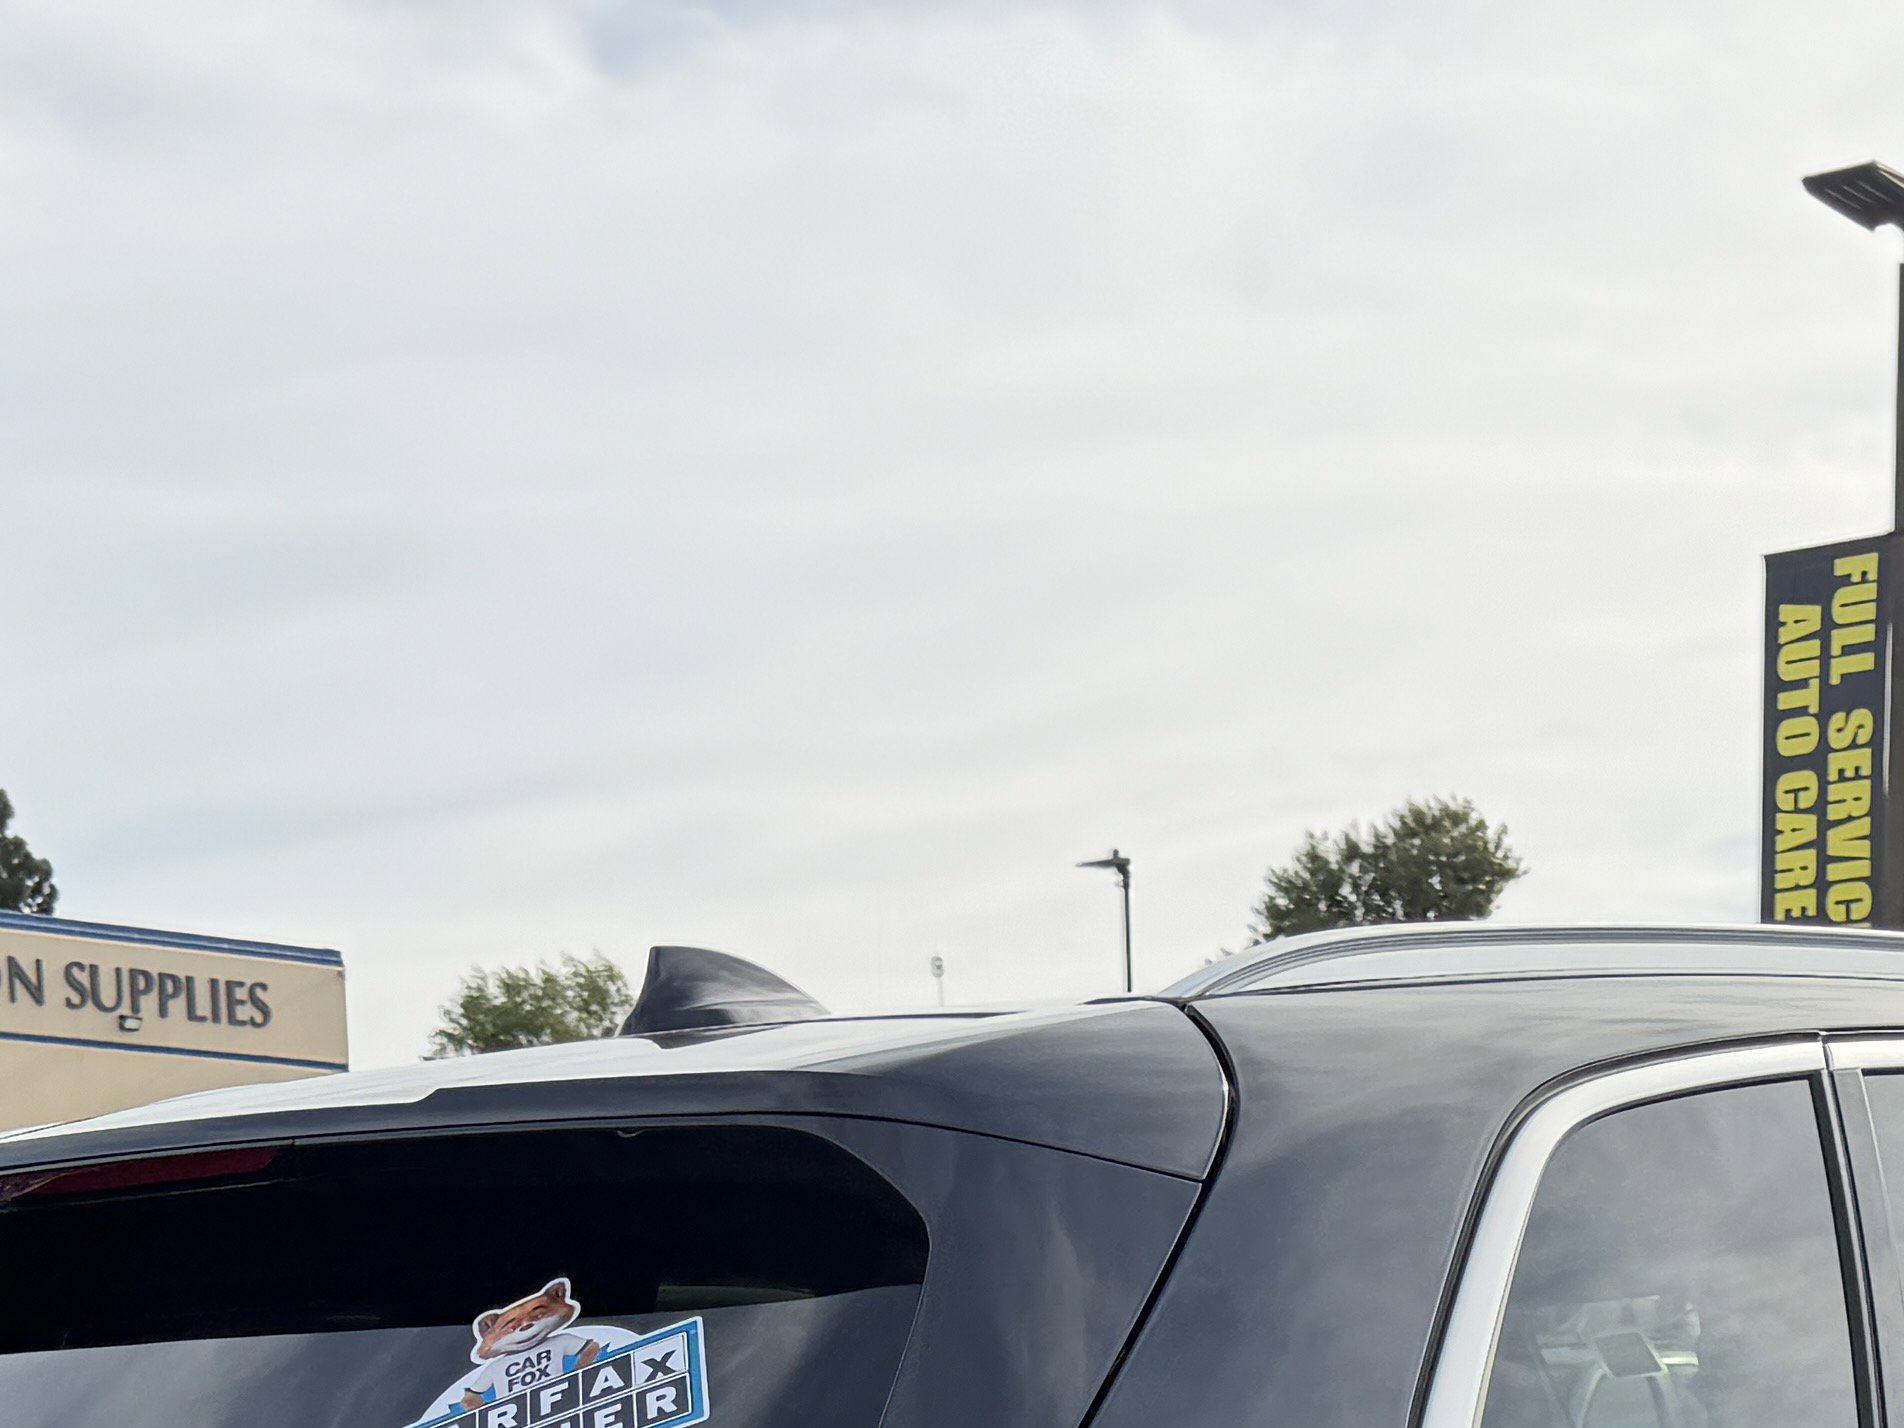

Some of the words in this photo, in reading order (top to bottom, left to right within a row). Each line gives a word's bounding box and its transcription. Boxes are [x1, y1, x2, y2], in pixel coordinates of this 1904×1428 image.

[1776, 603, 1823, 758] AUTO
[1828, 551, 1880, 686] FULL
[1773, 769, 1819, 922] CARE
[1825, 707, 1874, 929] SERVIC
[63, 961, 273, 1028] SUPPLIES
[504, 1347, 553, 1379] CAR
[507, 1363, 552, 1393] FOX
